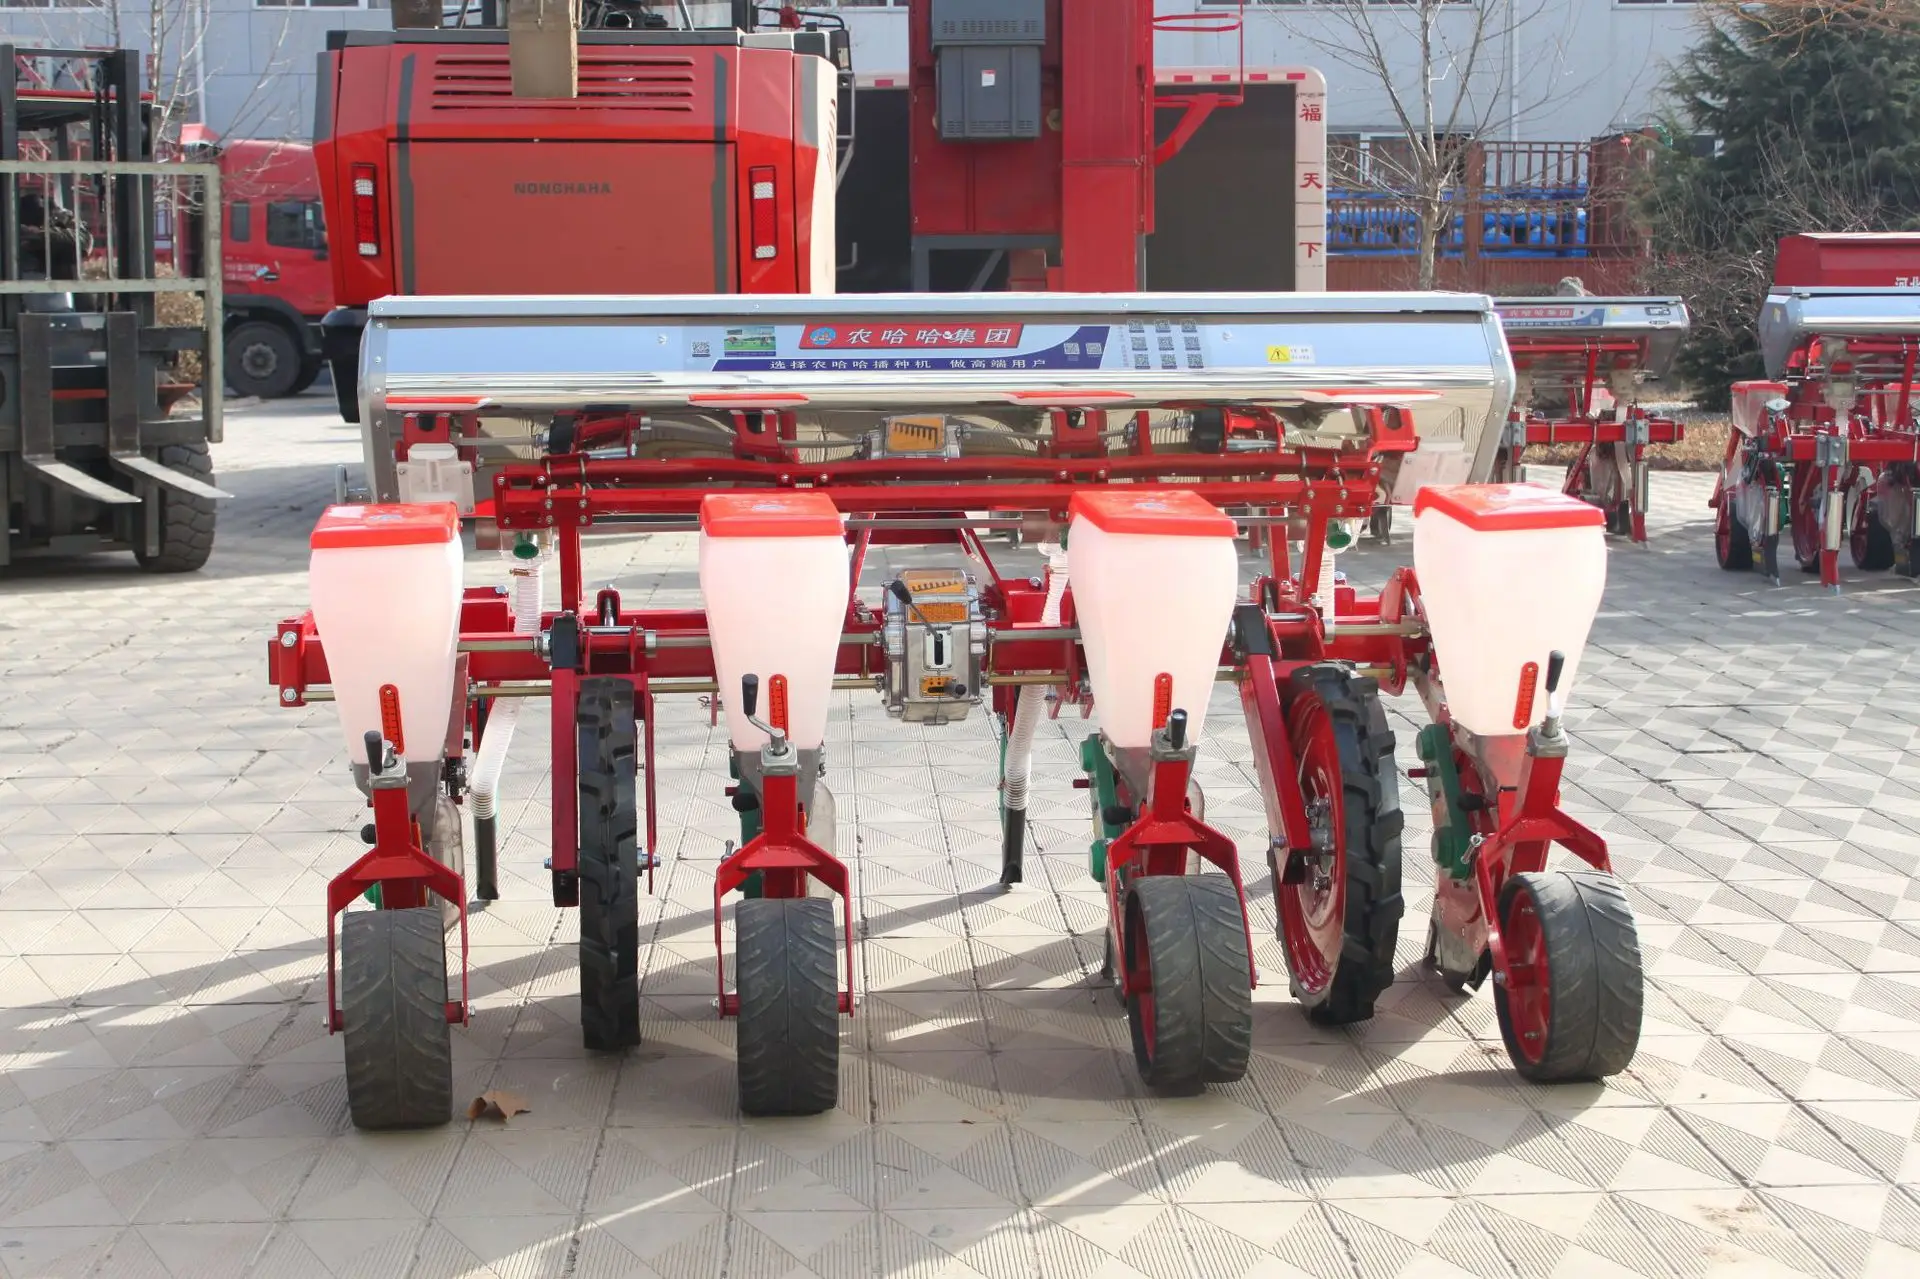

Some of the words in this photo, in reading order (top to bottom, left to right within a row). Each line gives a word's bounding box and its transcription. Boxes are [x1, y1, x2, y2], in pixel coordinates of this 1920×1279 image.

[513, 182, 612, 195] NONGHAHA
[847, 327, 1012, 345] 农哈哈集团
[769, 359, 931, 369] 选择农哈哈播种机
[950, 359, 1046, 369] 做高端用户
